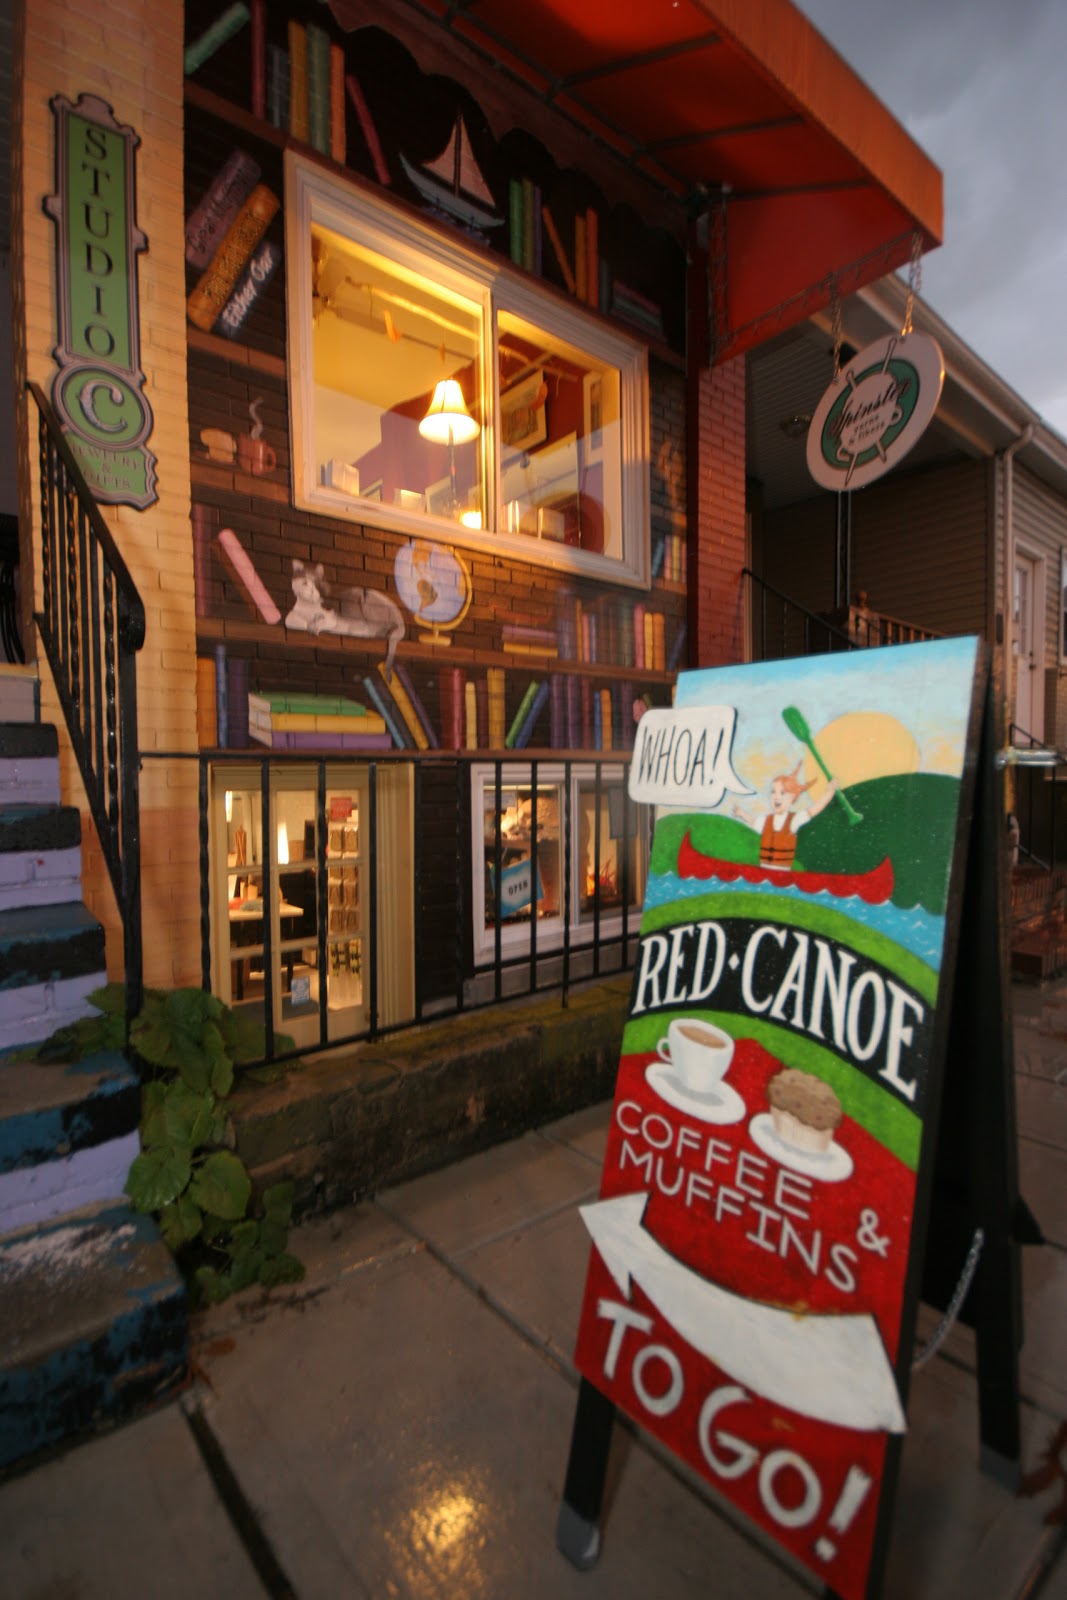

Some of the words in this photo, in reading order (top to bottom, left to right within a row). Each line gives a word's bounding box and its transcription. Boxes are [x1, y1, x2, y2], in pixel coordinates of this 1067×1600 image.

[82, 127, 115, 358] STUDIO
[78, 379, 128, 433] C
[638, 726, 724, 786] WHOA!
[508, 880, 528, 896] OPEN
[631, 921, 726, 1015] RED
[740, 925, 924, 1100] CANOE
[616, 1100, 813, 1220] COFFEE
[619, 1140, 857, 1293] MUFFINS
[856, 1208, 890, 1258] &
[597, 1298, 684, 1417] TO
[699, 1385, 872, 1562] GO!
